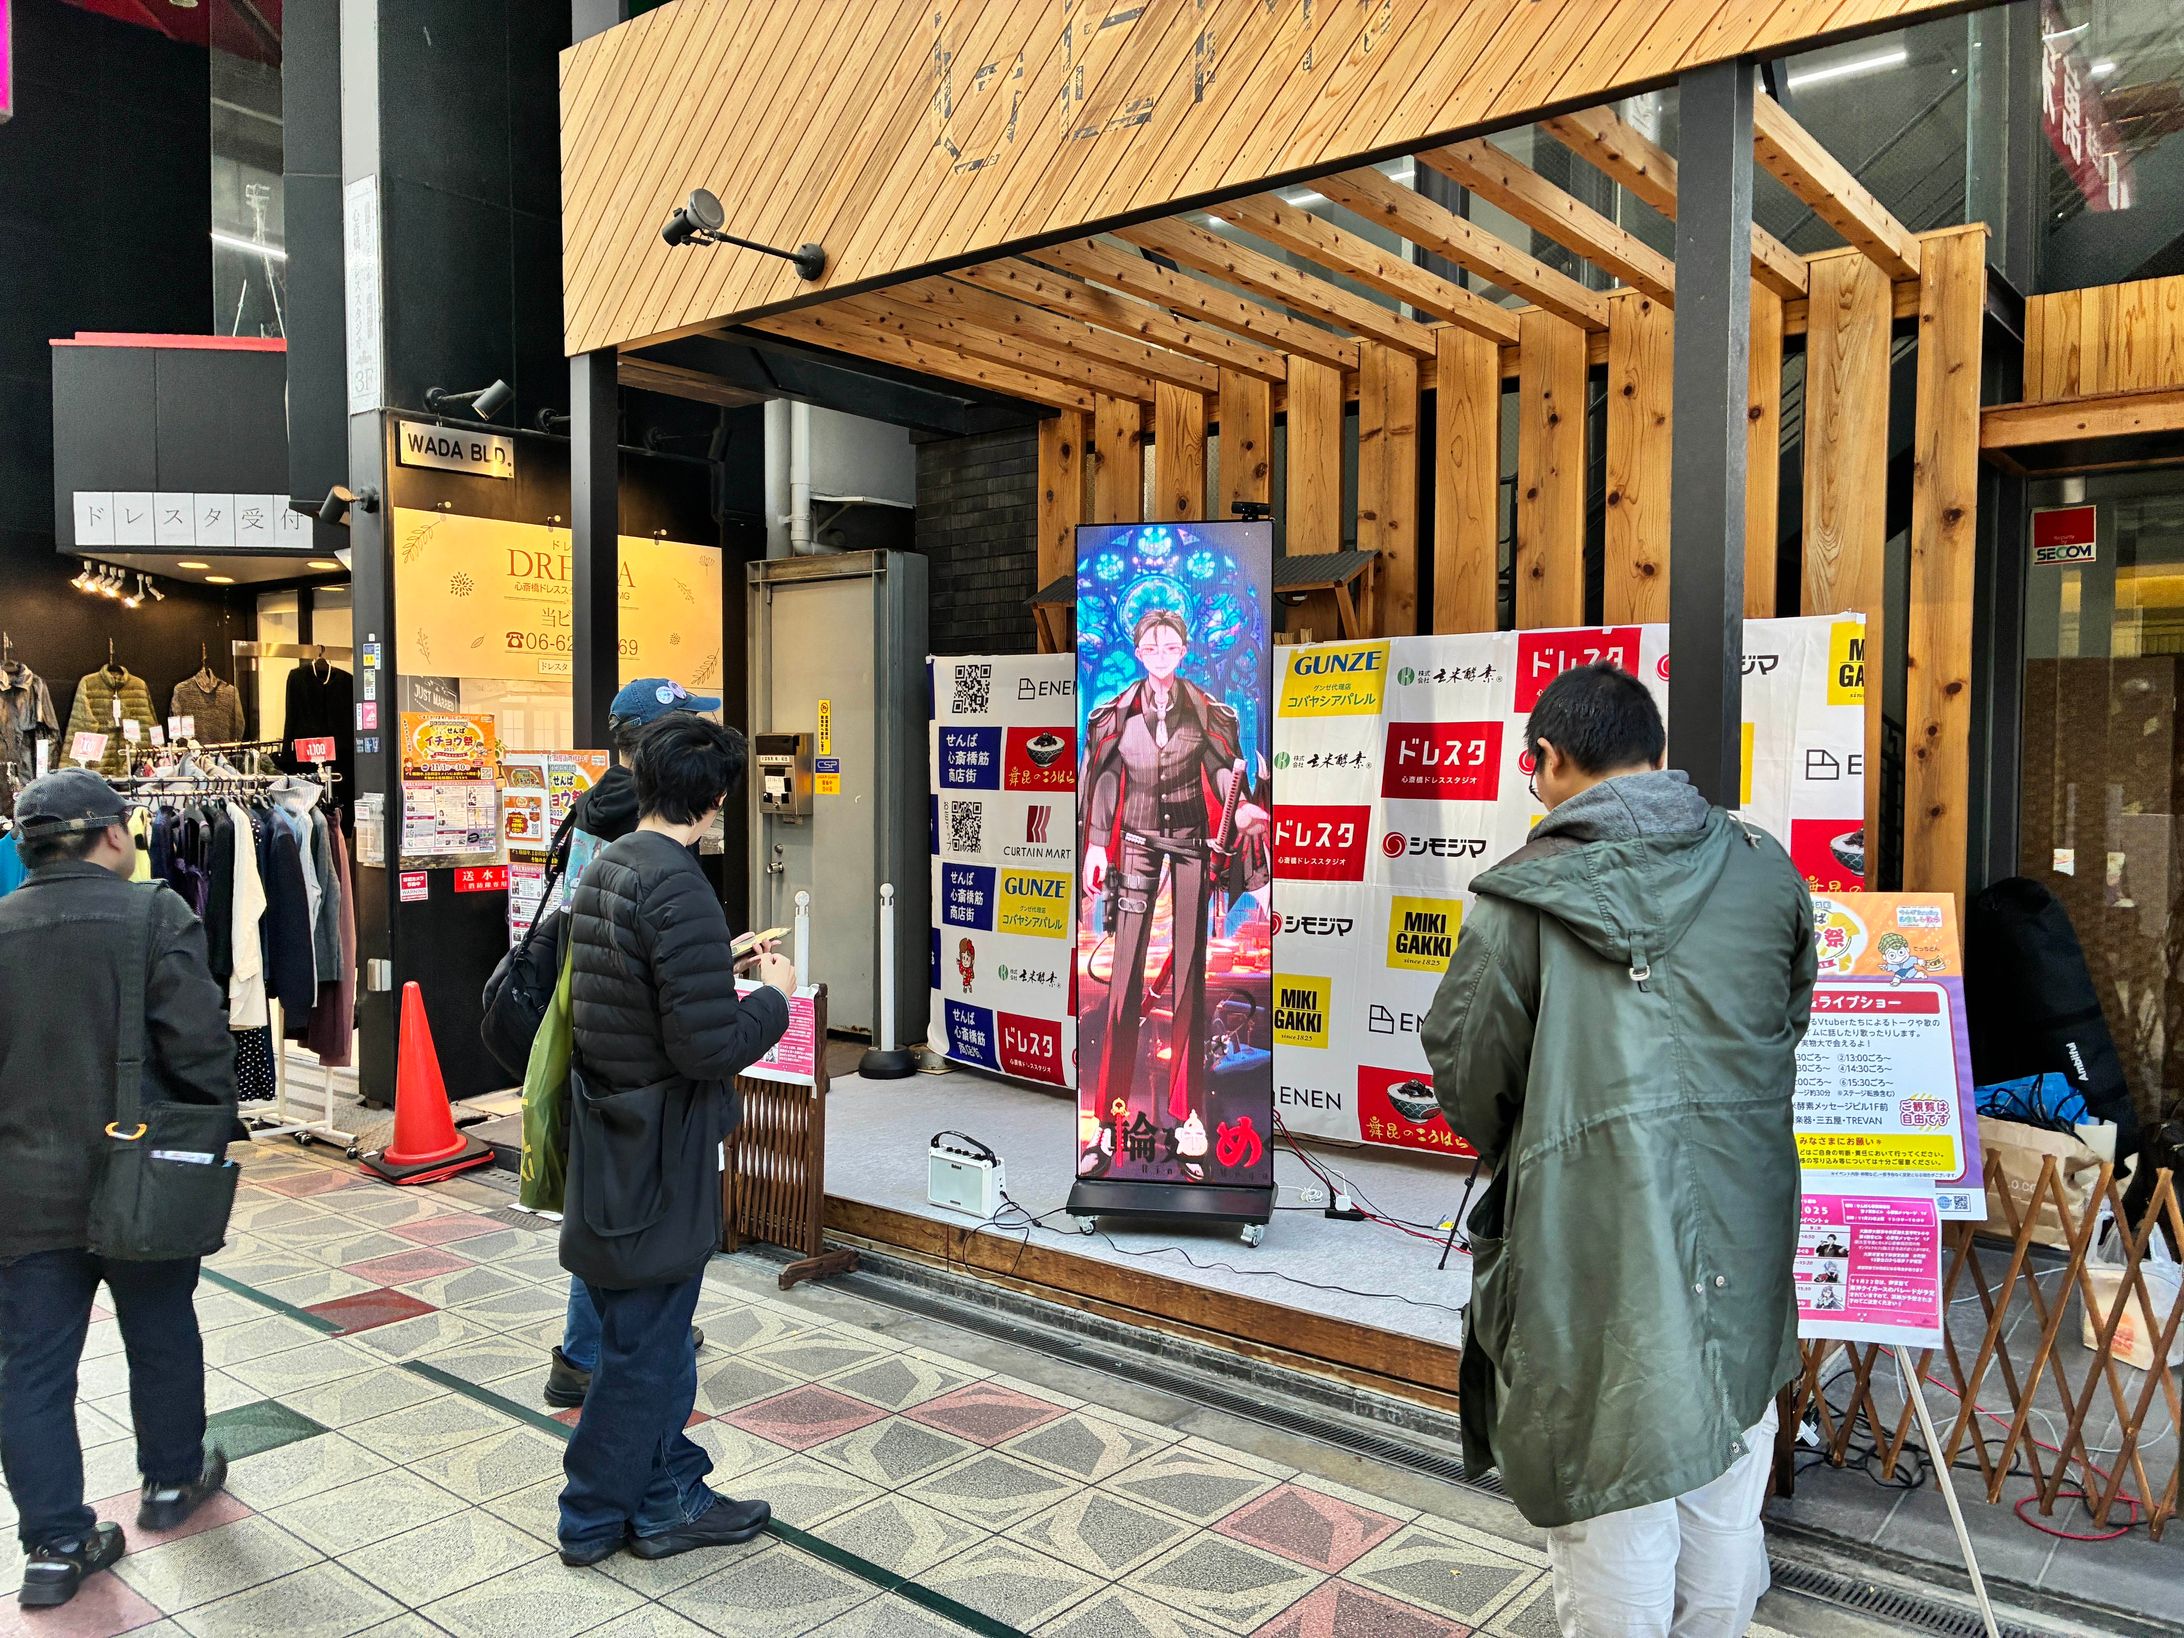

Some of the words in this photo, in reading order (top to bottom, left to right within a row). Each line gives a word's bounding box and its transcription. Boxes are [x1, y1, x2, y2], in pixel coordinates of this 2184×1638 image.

[407, 432, 464, 460] WADA
[470, 443, 511, 467] BLD.
[88, 505, 303, 531] ドレスタ受付
[2036, 545, 2091, 561] SECOM
[1294, 650, 1382, 676] GUNZE
[414, 683, 431, 703] JUST
[1313, 682, 1352, 692] グンゼ代理店
[1287, 692, 1377, 708] コバヤシアパレル
[946, 732, 979, 747] せんば
[948, 751, 990, 766] 心斎橋筋
[1398, 738, 1487, 766] ドレスタ
[817, 761, 837, 769] CSP
[553, 775, 574, 786] せんば
[949, 768, 977, 783] 商店街
[1401, 776, 1478, 785] 心斎橋ドレススタジオ
[1274, 820, 1355, 848] ドレスタ
[1003, 846, 1044, 858] CURTAIN
[1045, 848, 1071, 859] MART
[1409, 837, 1487, 858] シモジマ
[950, 872, 974, 885] せんば
[1005, 877, 1066, 898] GUNZE
[950, 889, 983, 905] 心斎橋筋
[950, 905, 974, 922] 商店街
[1002, 914, 1062, 930] コバヤシアパレル
[1284, 915, 1354, 937] シモジマ
[1404, 911, 1447, 934] MIKI
[1395, 933, 1452, 958] GAKKI
[1280, 988, 1317, 1010] MIKI
[952, 1008, 976, 1025] せんば
[1274, 1009, 1322, 1033] GAKKI
[954, 1025, 986, 1047] 心斎橋筋
[1004, 1026, 1054, 1058] ドレスタ
[1280, 1086, 1342, 1111] ENEN
[1901, 1100, 1949, 1112] ご観覧は
[1901, 1113, 1949, 1126] 自由です
